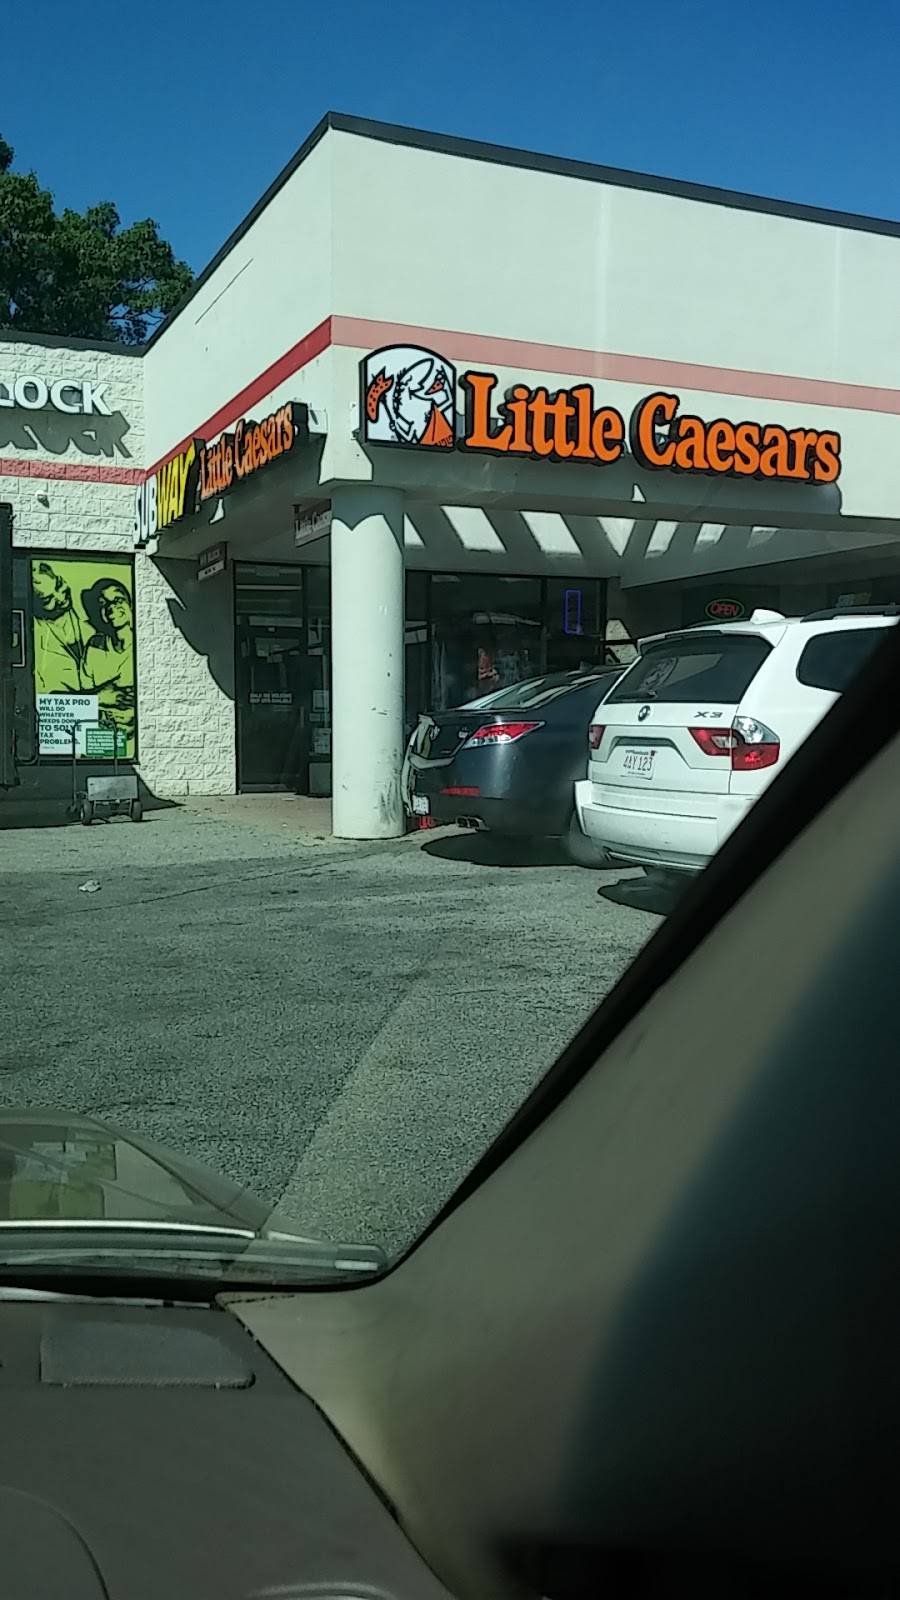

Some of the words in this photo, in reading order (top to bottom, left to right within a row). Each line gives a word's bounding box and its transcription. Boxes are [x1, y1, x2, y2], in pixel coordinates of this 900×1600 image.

[200, 434, 234, 501] Little
[234, 402, 293, 480] Caesars
[464, 373, 623, 463] Little
[636, 393, 841, 484] Caesars
[133, 437, 195, 544] SUBWAY
[709, 601, 740, 616] OPEN
[39, 698, 52, 706] MY
[54, 698, 71, 706] TAX
